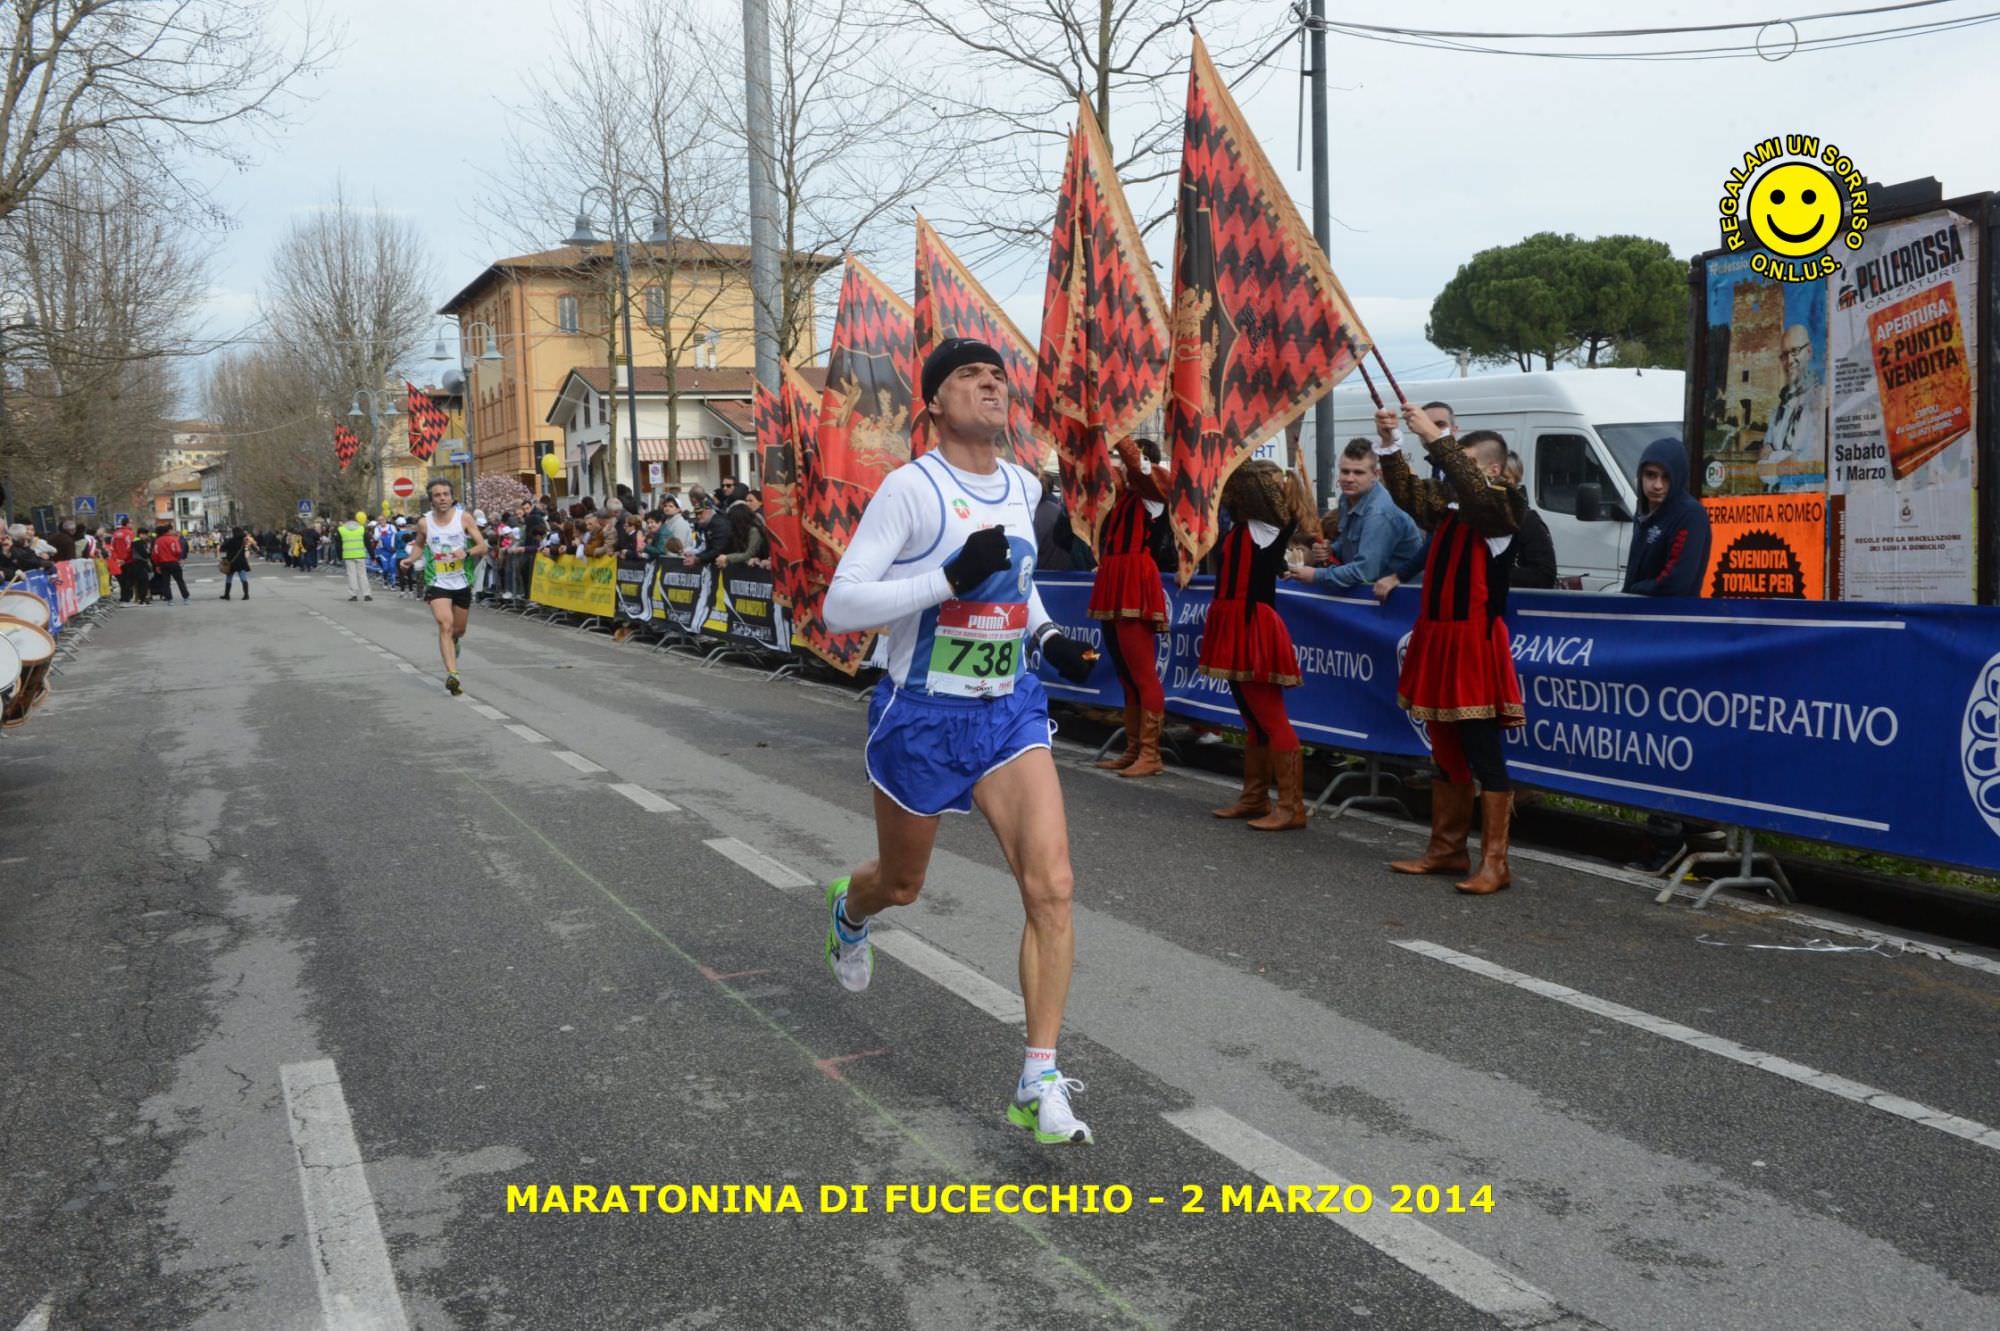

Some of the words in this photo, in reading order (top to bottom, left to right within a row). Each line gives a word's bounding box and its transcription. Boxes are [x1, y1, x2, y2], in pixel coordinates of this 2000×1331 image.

[1855, 224, 1965, 303] PELLEROSSA
[1864, 263, 1962, 310] CALZATURE
[1876, 297, 1951, 341] APERTURA
[1880, 345, 1892, 367] 2
[1895, 321, 1954, 360] PUNTO
[1883, 346, 1959, 390] VENDITA
[1252, 445, 1275, 458] RT
[1835, 443, 1886, 462] Sabato
[1835, 467, 1841, 481] 1
[1846, 465, 1886, 481] Marzo
[1777, 502, 1823, 523] ROMEO
[1728, 549, 1788, 569] SVENDITA
[1722, 573, 1767, 593] TOTALE
[1769, 573, 1794, 593] PER
[968, 615, 1006, 630] PUMA
[1178, 603, 1211, 625] BAN
[947, 639, 1013, 678] 738
[1176, 634, 1189, 657] DI
[1510, 634, 1594, 667] BANCA
[1534, 675, 1648, 718] CREDITO
[1658, 686, 1899, 747] COOPERATIVO
[1534, 719, 1693, 772] CAMBIANO
